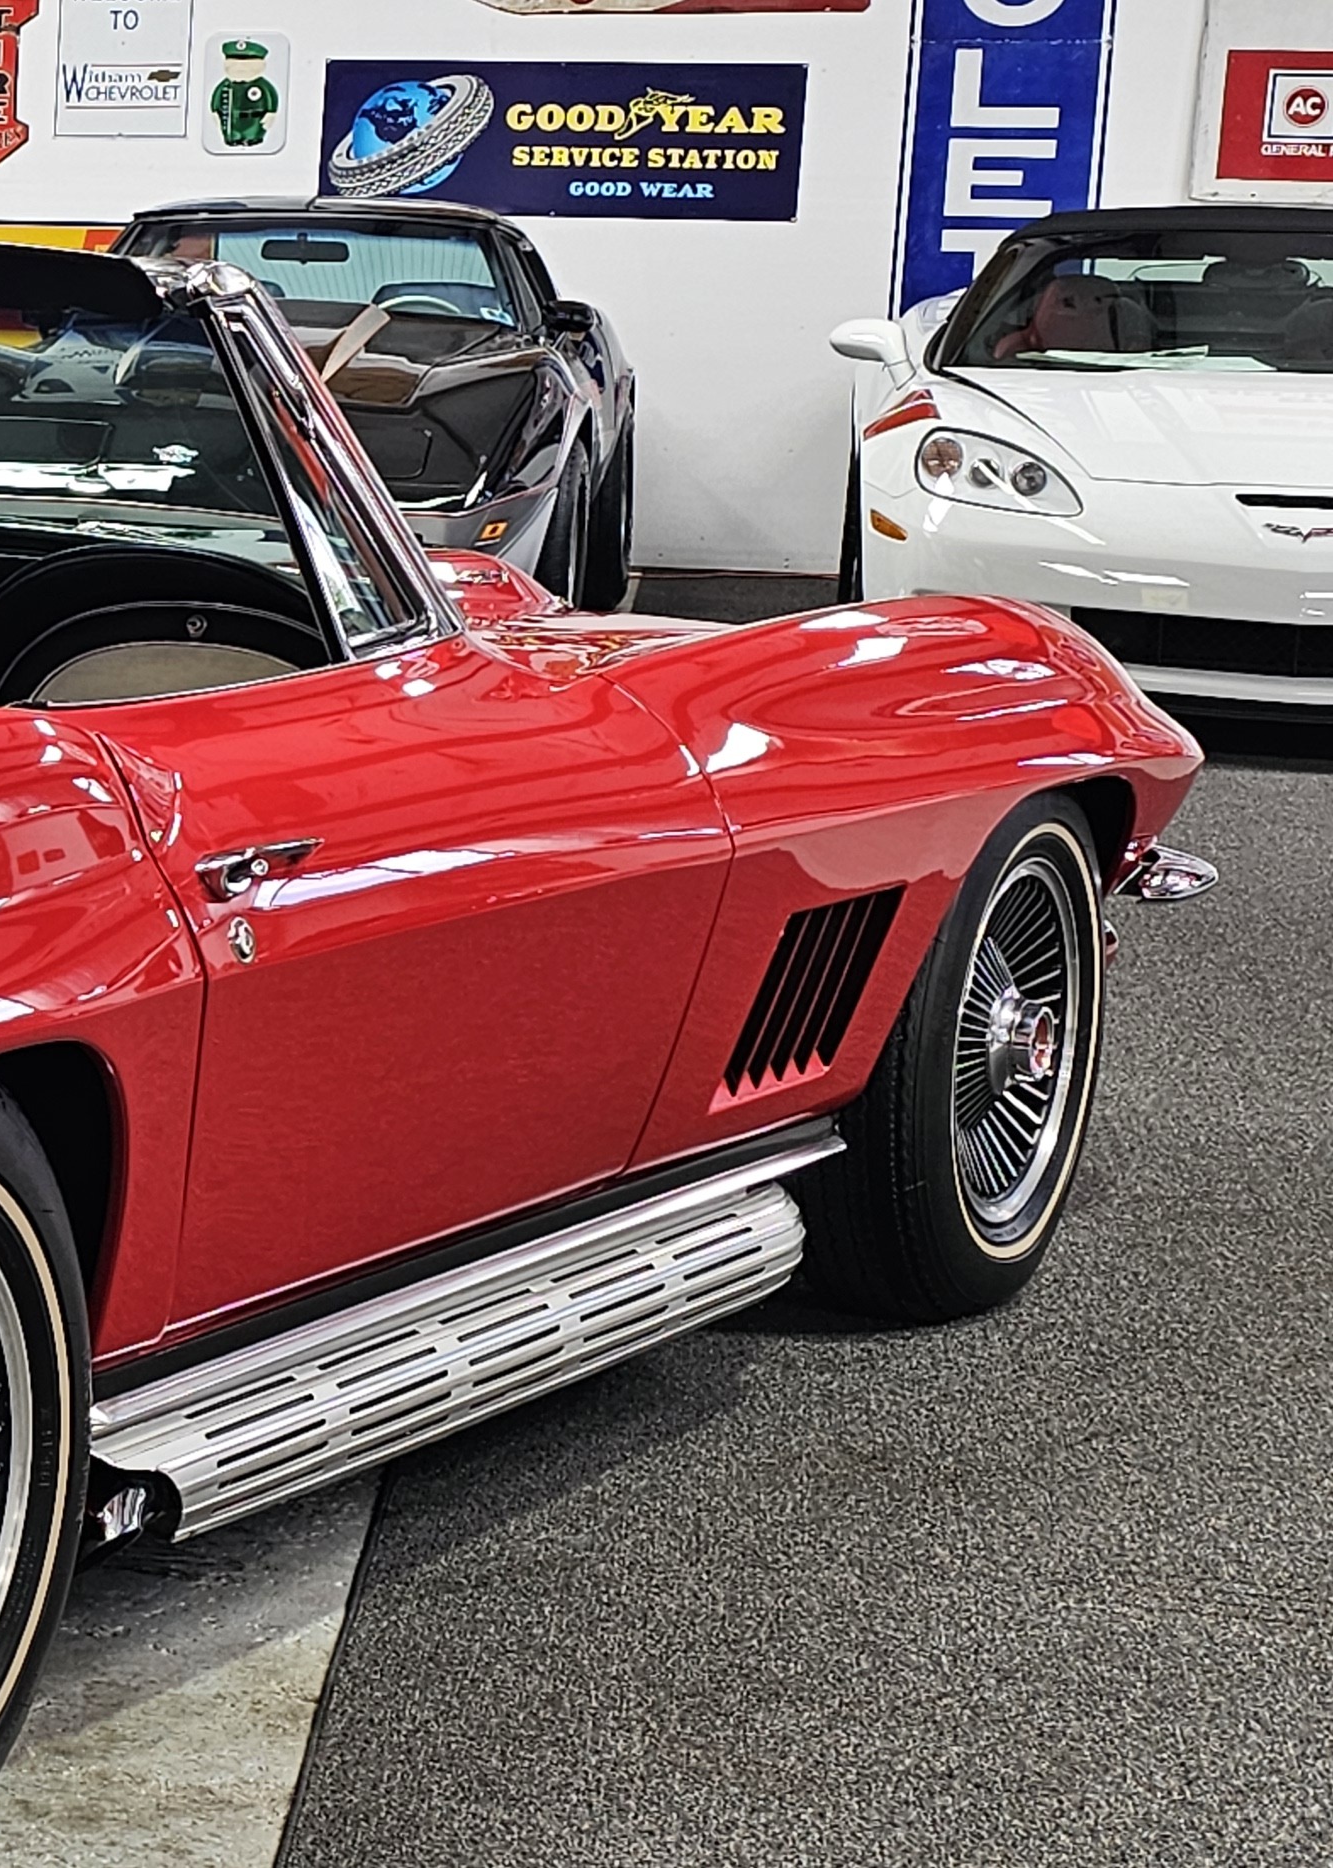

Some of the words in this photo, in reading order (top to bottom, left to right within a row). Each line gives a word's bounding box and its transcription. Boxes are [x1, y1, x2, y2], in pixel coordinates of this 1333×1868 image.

[109, 9, 140, 31] TO
[85, 84, 181, 101] CHEVROLET
[1287, 96, 1323, 117] AC
[512, 145, 640, 169] SERVICE
[647, 148, 780, 171] STATION
[1260, 143, 1327, 157] GENERAL
[568, 181, 632, 197] GOOD
[639, 182, 715, 199] WEAR
